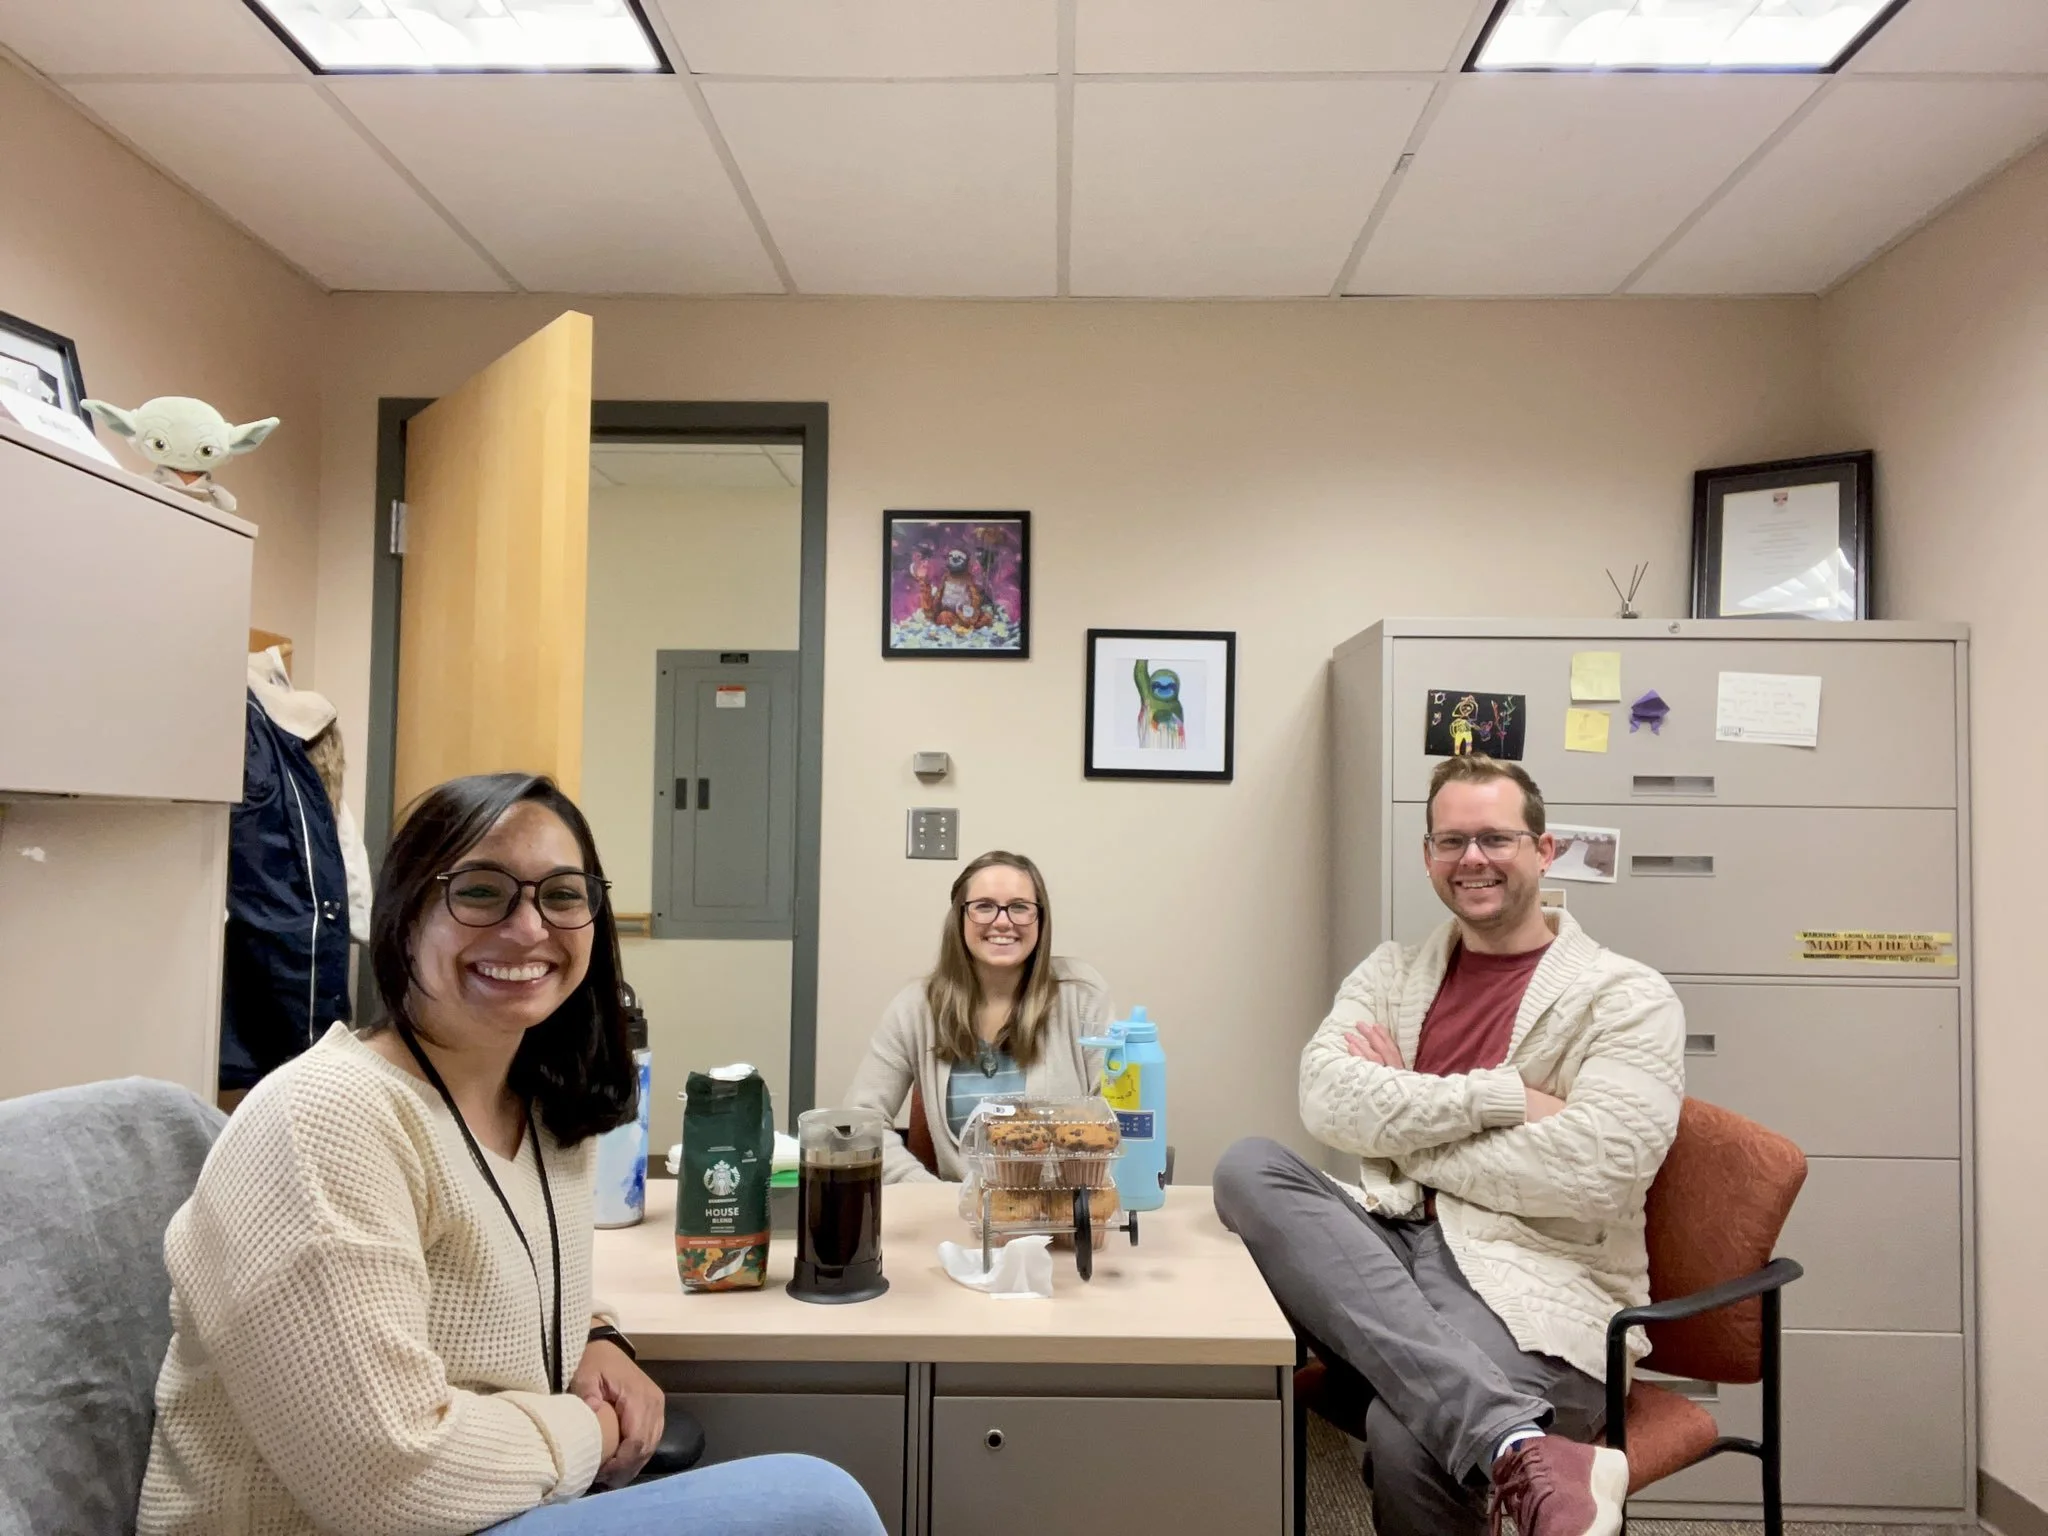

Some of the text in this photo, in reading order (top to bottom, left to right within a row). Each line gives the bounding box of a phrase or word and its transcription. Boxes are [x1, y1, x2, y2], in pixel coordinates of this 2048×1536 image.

[1857, 940, 1872, 951] IN
[1876, 941, 1906, 951] THE
[1909, 941, 1938, 951] U.K.
[705, 1206, 740, 1217] HOUSE
